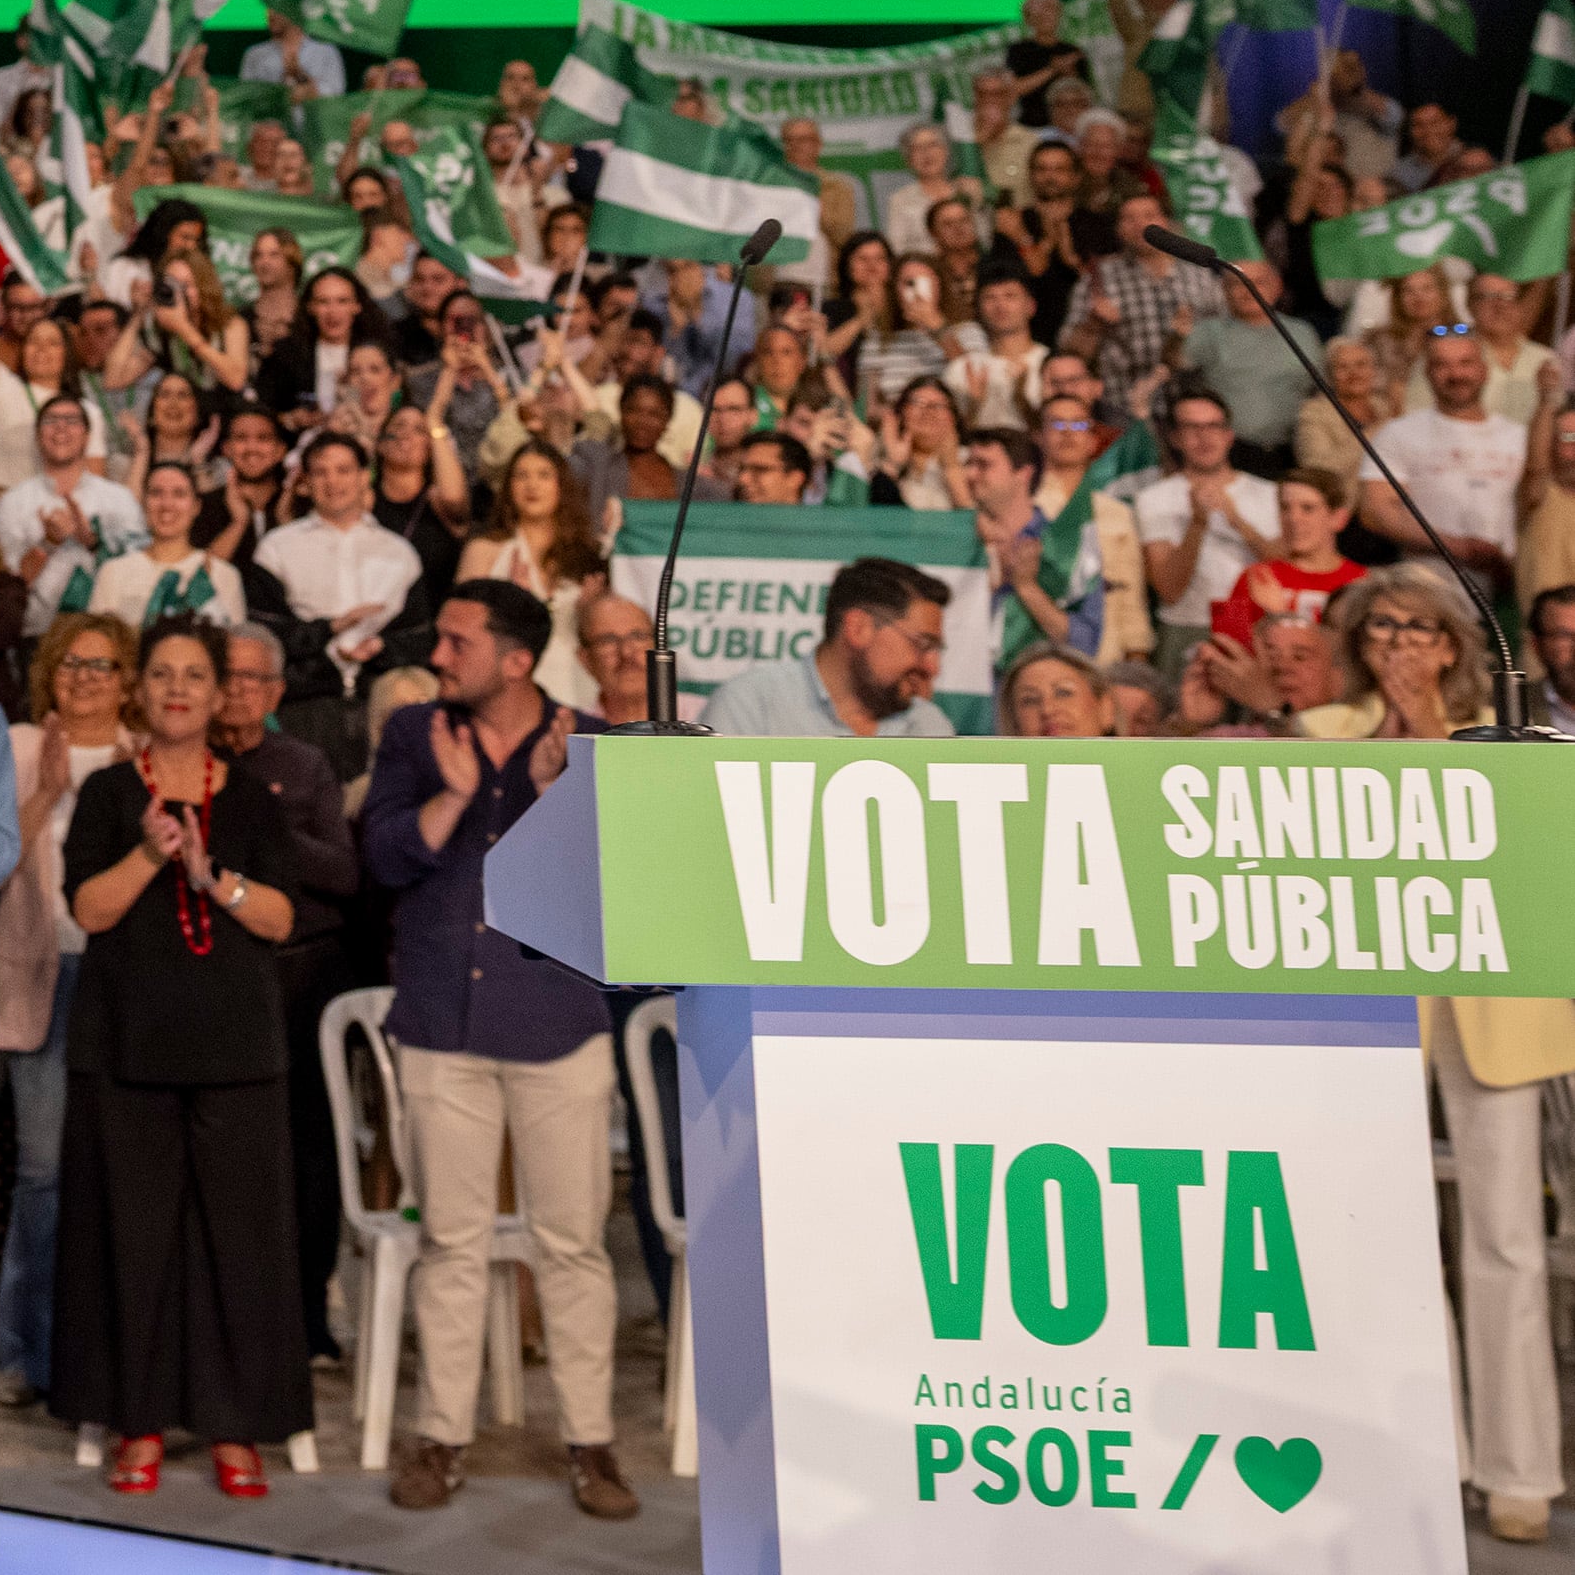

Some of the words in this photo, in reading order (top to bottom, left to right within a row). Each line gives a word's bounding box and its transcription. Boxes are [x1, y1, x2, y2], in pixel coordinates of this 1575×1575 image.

[713, 759, 1142, 968] VOTA
[1161, 764, 1499, 862] SANIDAD
[1167, 860, 1510, 973] PÚBLICA
[898, 1142, 1317, 1352] VOTA
[915, 1374, 1132, 1415] Andalucía
[915, 1424, 1137, 1510] PSOE
